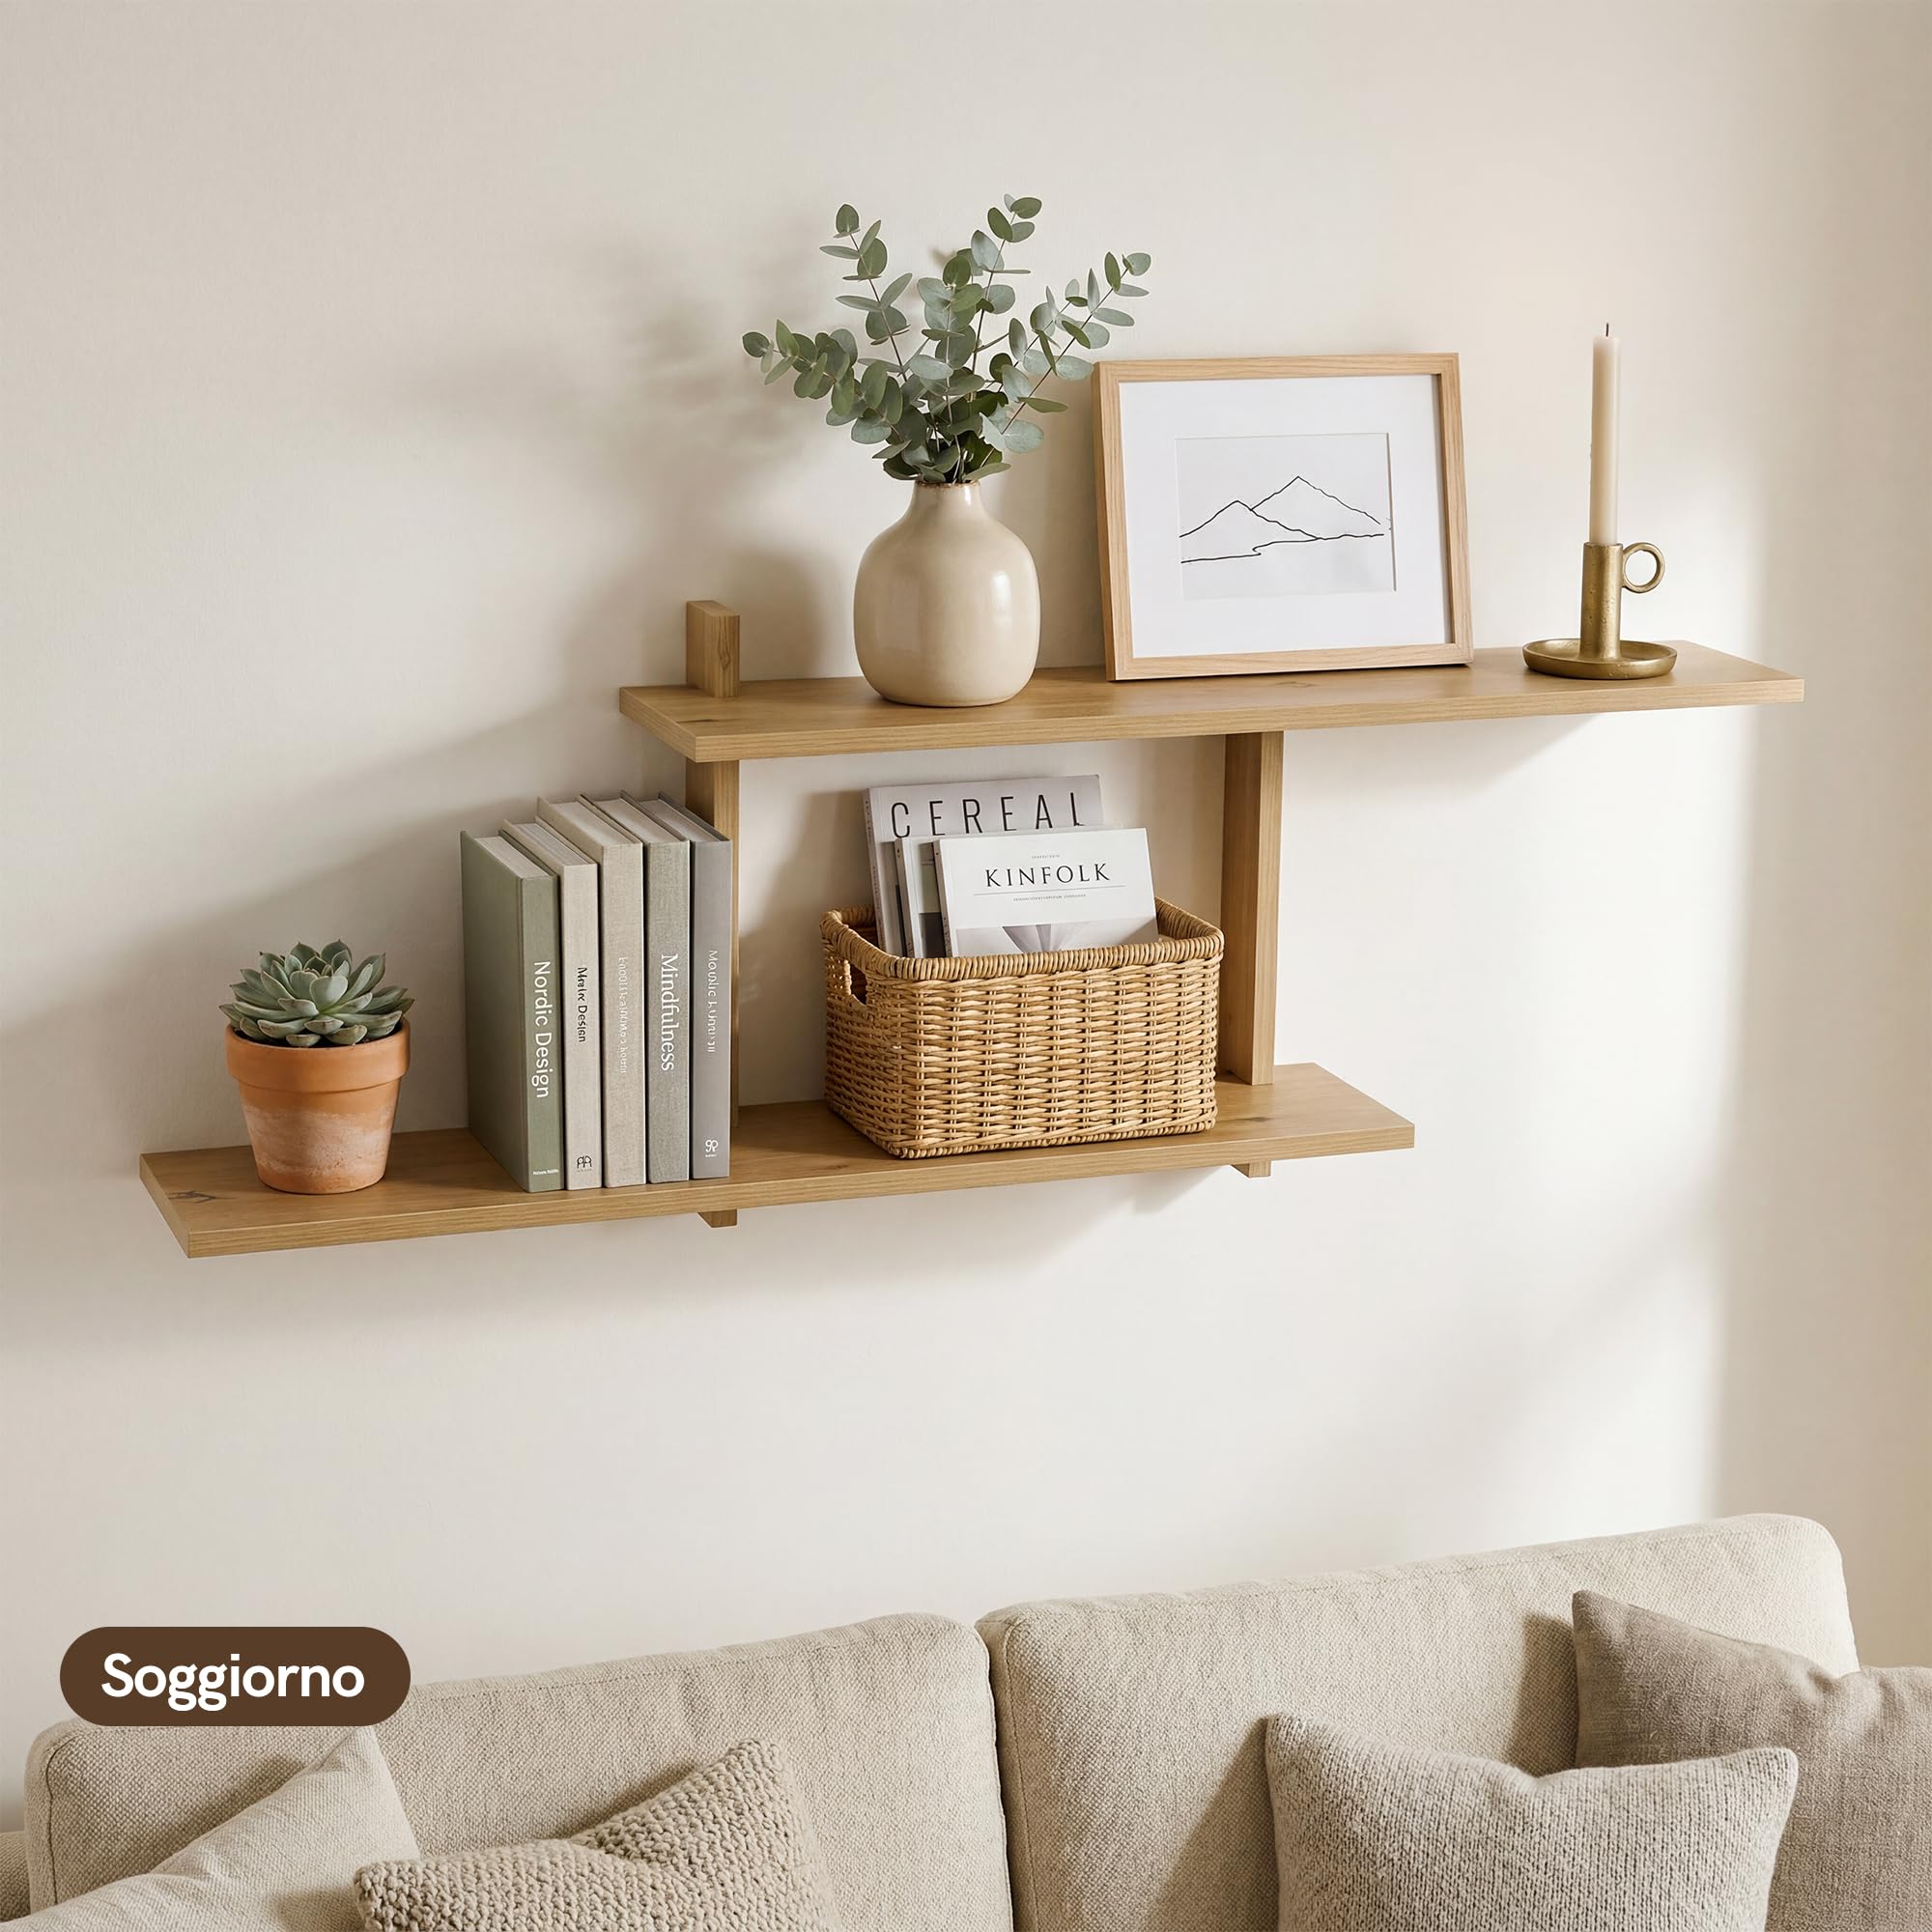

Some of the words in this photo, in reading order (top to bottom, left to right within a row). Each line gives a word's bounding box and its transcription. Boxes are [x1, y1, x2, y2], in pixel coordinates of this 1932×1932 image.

[891, 792, 1086, 838] CEREAL
[985, 863, 1111, 887] KINFOLK
[533, 961, 553, 1026] Nordic
[661, 952, 680, 1071] Mindfulness
[531, 1032, 553, 1098] Design
